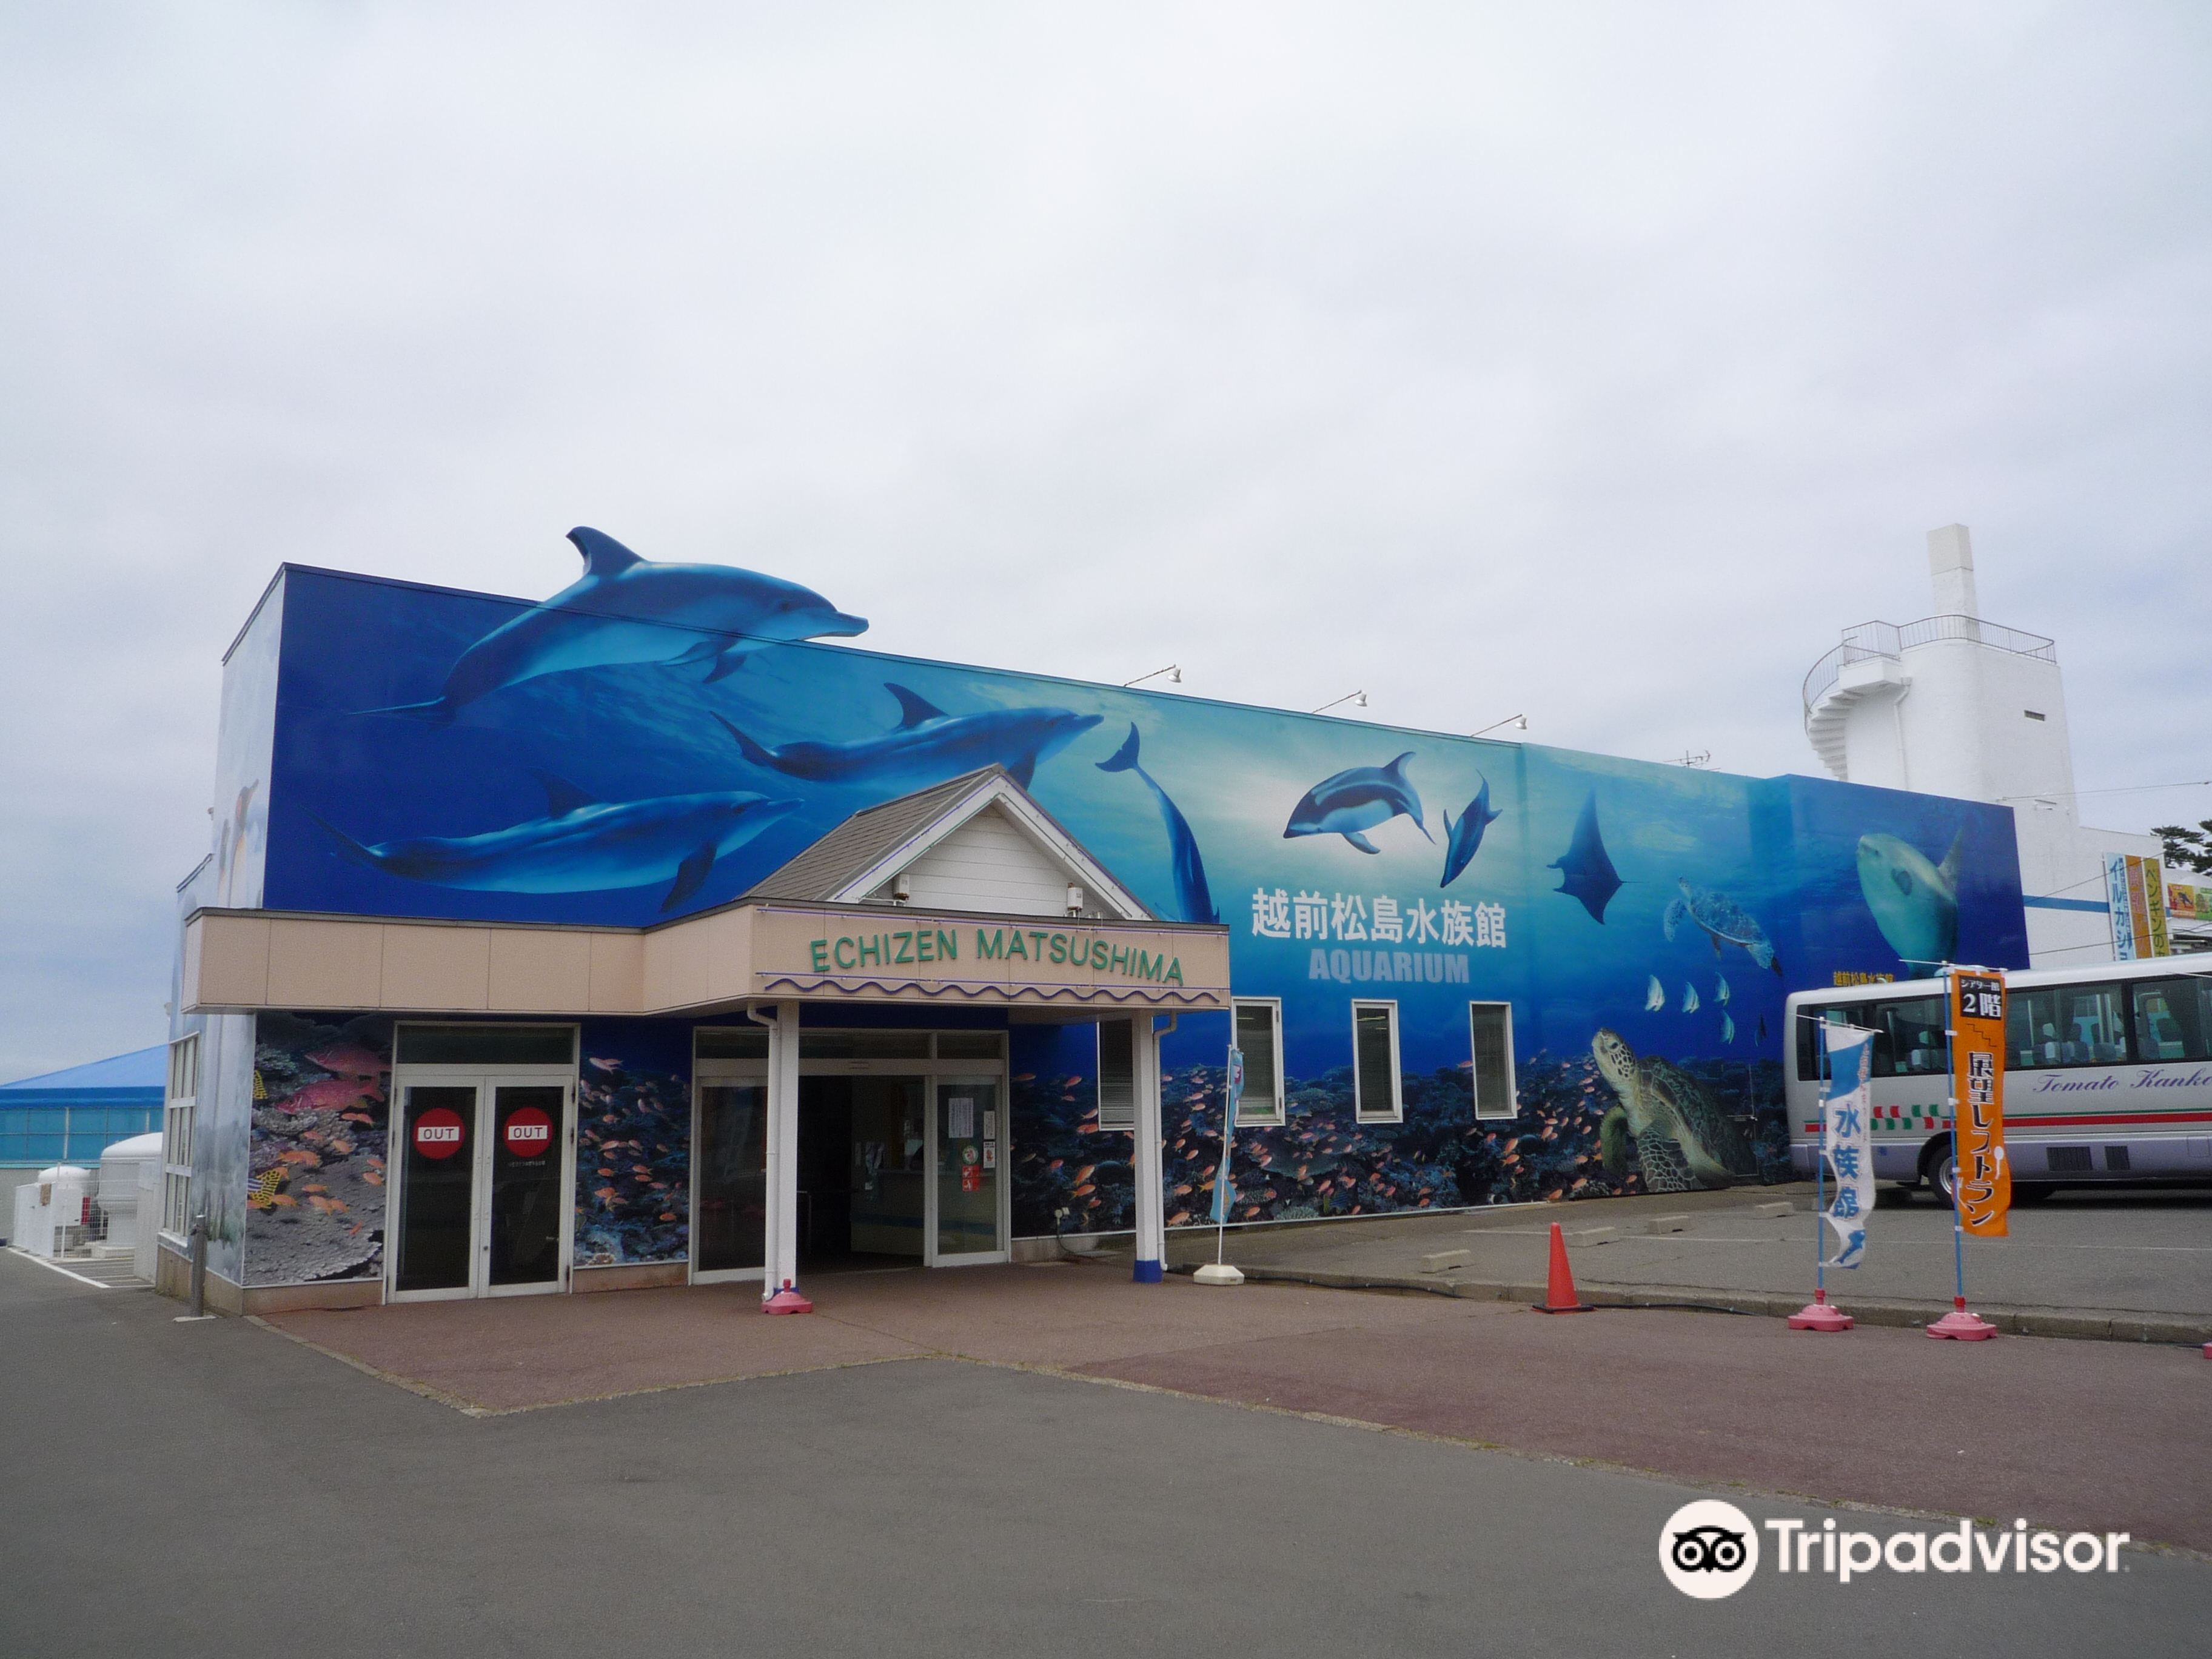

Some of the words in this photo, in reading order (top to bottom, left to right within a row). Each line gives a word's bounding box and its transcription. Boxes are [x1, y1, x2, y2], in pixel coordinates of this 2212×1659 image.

[1252, 888, 1507, 948] 越前松島水族館
[811, 930, 957, 971] ECHIZEN
[977, 928, 1184, 985] MATSUSHIMA
[1309, 948, 1469, 984] AQUARIUM
[1963, 993, 2001, 1017] 2階
[2033, 1074, 2119, 1092] Tomato
[424, 1128, 454, 1140] OUT
[513, 1127, 543, 1138] OUT
[1967, 1051, 1994, 1225] 展望レストラン
[1833, 1103, 1861, 1219] 水族館
